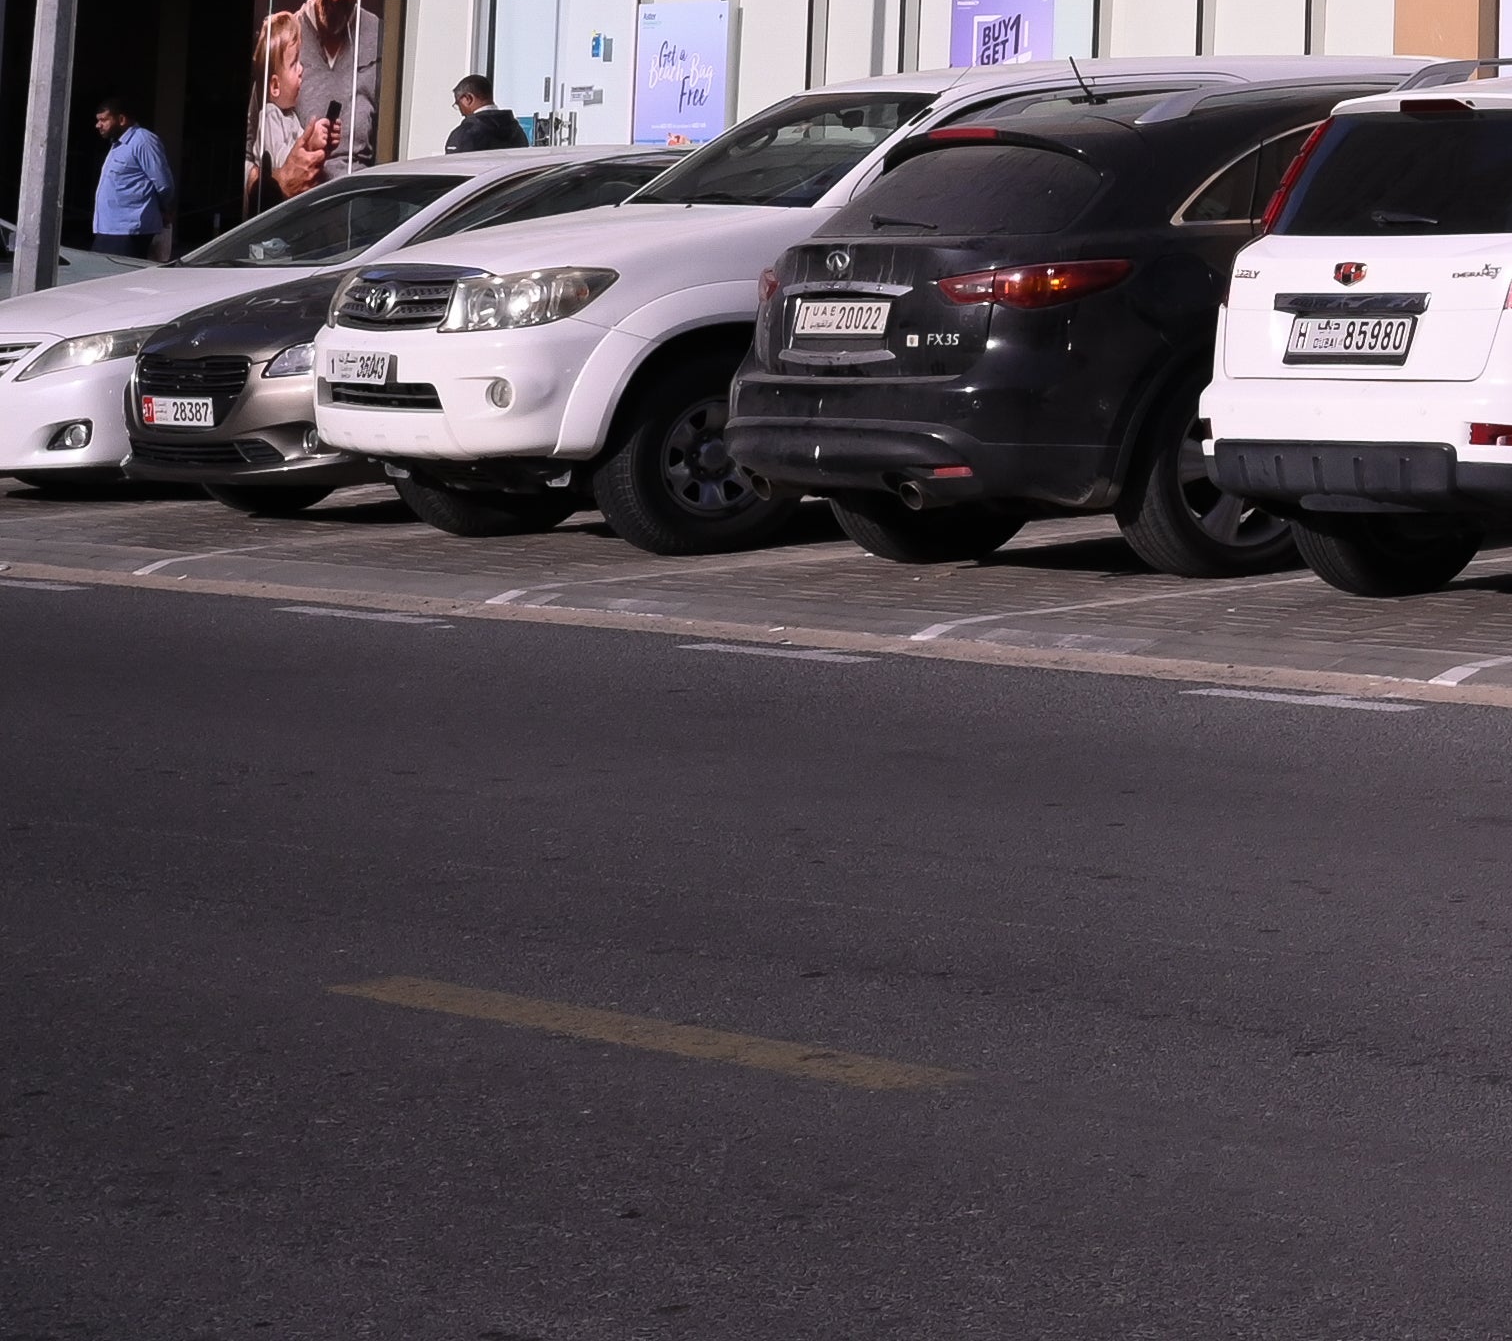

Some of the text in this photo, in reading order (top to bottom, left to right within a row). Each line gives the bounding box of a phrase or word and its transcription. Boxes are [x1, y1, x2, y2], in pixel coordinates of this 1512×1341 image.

[982, 16, 1012, 47] BUY
[659, 40, 677, 67] Get
[980, 37, 1009, 66] GET
[648, 53, 715, 95] Beach Bag
[678, 75, 709, 113] Free
[812, 305, 837, 317] UAE
[836, 306, 882, 330] 20022
[926, 333, 960, 346] FX35
[1296, 321, 1311, 349] H
[1343, 320, 1406, 351] 85980
[172, 401, 209, 422] 28387
